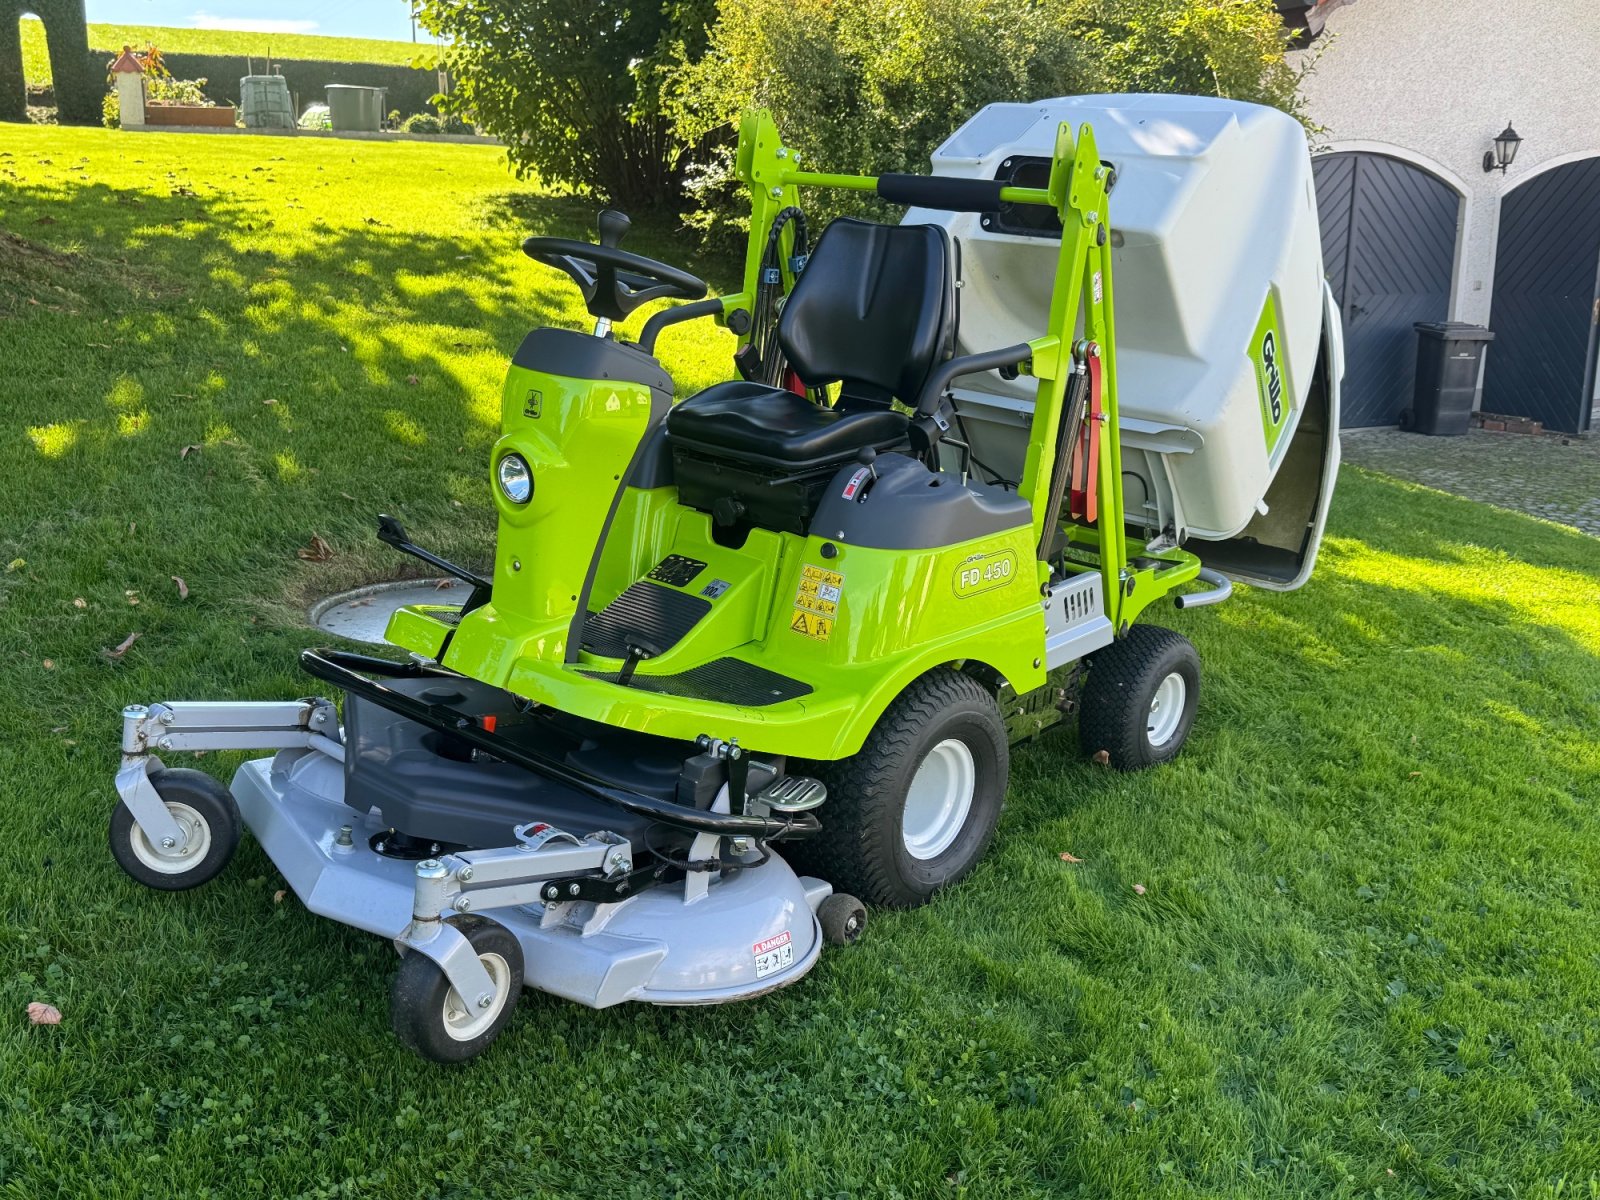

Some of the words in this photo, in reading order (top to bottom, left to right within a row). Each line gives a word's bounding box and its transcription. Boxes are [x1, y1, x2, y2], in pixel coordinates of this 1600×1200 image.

[1262, 331, 1281, 425] Grillo
[960, 567, 980, 590] FD
[983, 558, 1011, 581] 450
[761, 933, 790, 951] DANGER
